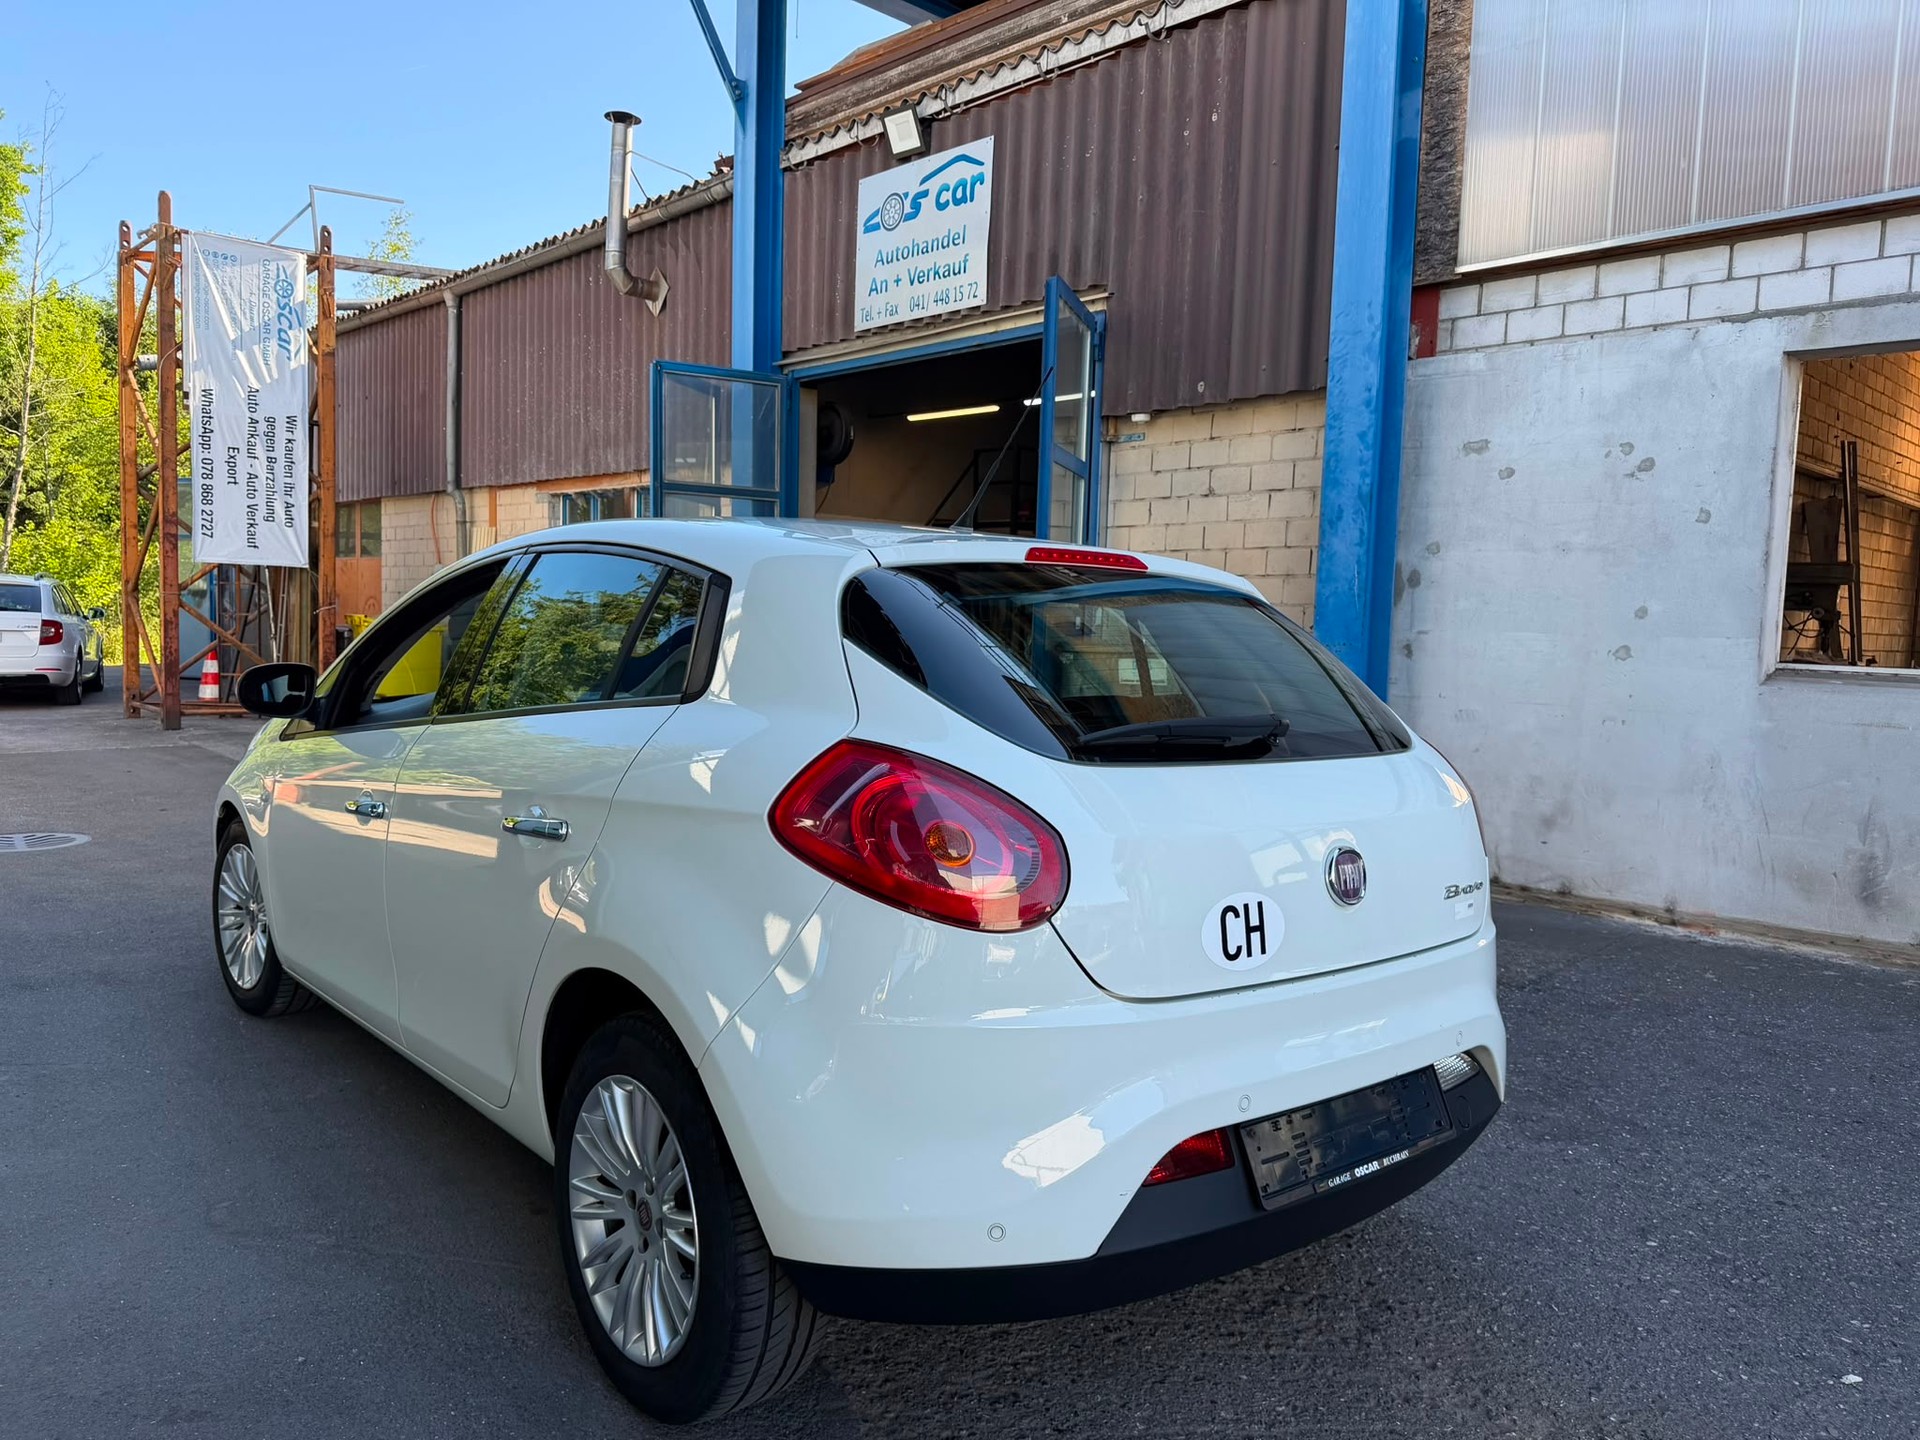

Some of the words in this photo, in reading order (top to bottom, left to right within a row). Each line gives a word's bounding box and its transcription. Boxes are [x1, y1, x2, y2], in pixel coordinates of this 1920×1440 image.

[874, 224, 967, 268] Autohandel
[262, 259, 271, 299] GARAGE
[868, 277, 888, 297] An
[893, 274, 902, 287] +
[907, 253, 969, 287] Verkauf
[262, 301, 271, 334] OSCAR
[860, 307, 874, 323] Tel.
[877, 308, 882, 319] +
[884, 301, 899, 318] Fax
[909, 292, 930, 313] 041/
[933, 287, 950, 307] 448
[953, 284, 964, 303] 15
[967, 281, 978, 299] 72
[262, 337, 271, 366] GMBH
[247, 385, 259, 413] Auto
[199, 388, 214, 454] WhatsApp:
[263, 416, 276, 452] gegen
[285, 415, 297, 434] Wir
[247, 417, 260, 460] Ankauf
[200, 458, 214, 480] 078
[225, 446, 240, 486] Export
[284, 438, 297, 478] kaufen
[200, 484, 214, 506] 868
[247, 472, 259, 499] Auto
[263, 456, 278, 523] Barzahlung
[283, 480, 296, 499] ihr
[200, 509, 214, 539] 2727
[246, 503, 259, 549] Verkauf
[283, 501, 295, 528] Auto
[1338, 863, 1361, 891] FIAT
[1219, 900, 1267, 962] CH
[1328, 1172, 1351, 1187] GARAGE
[1354, 1161, 1380, 1177] OSCAR
